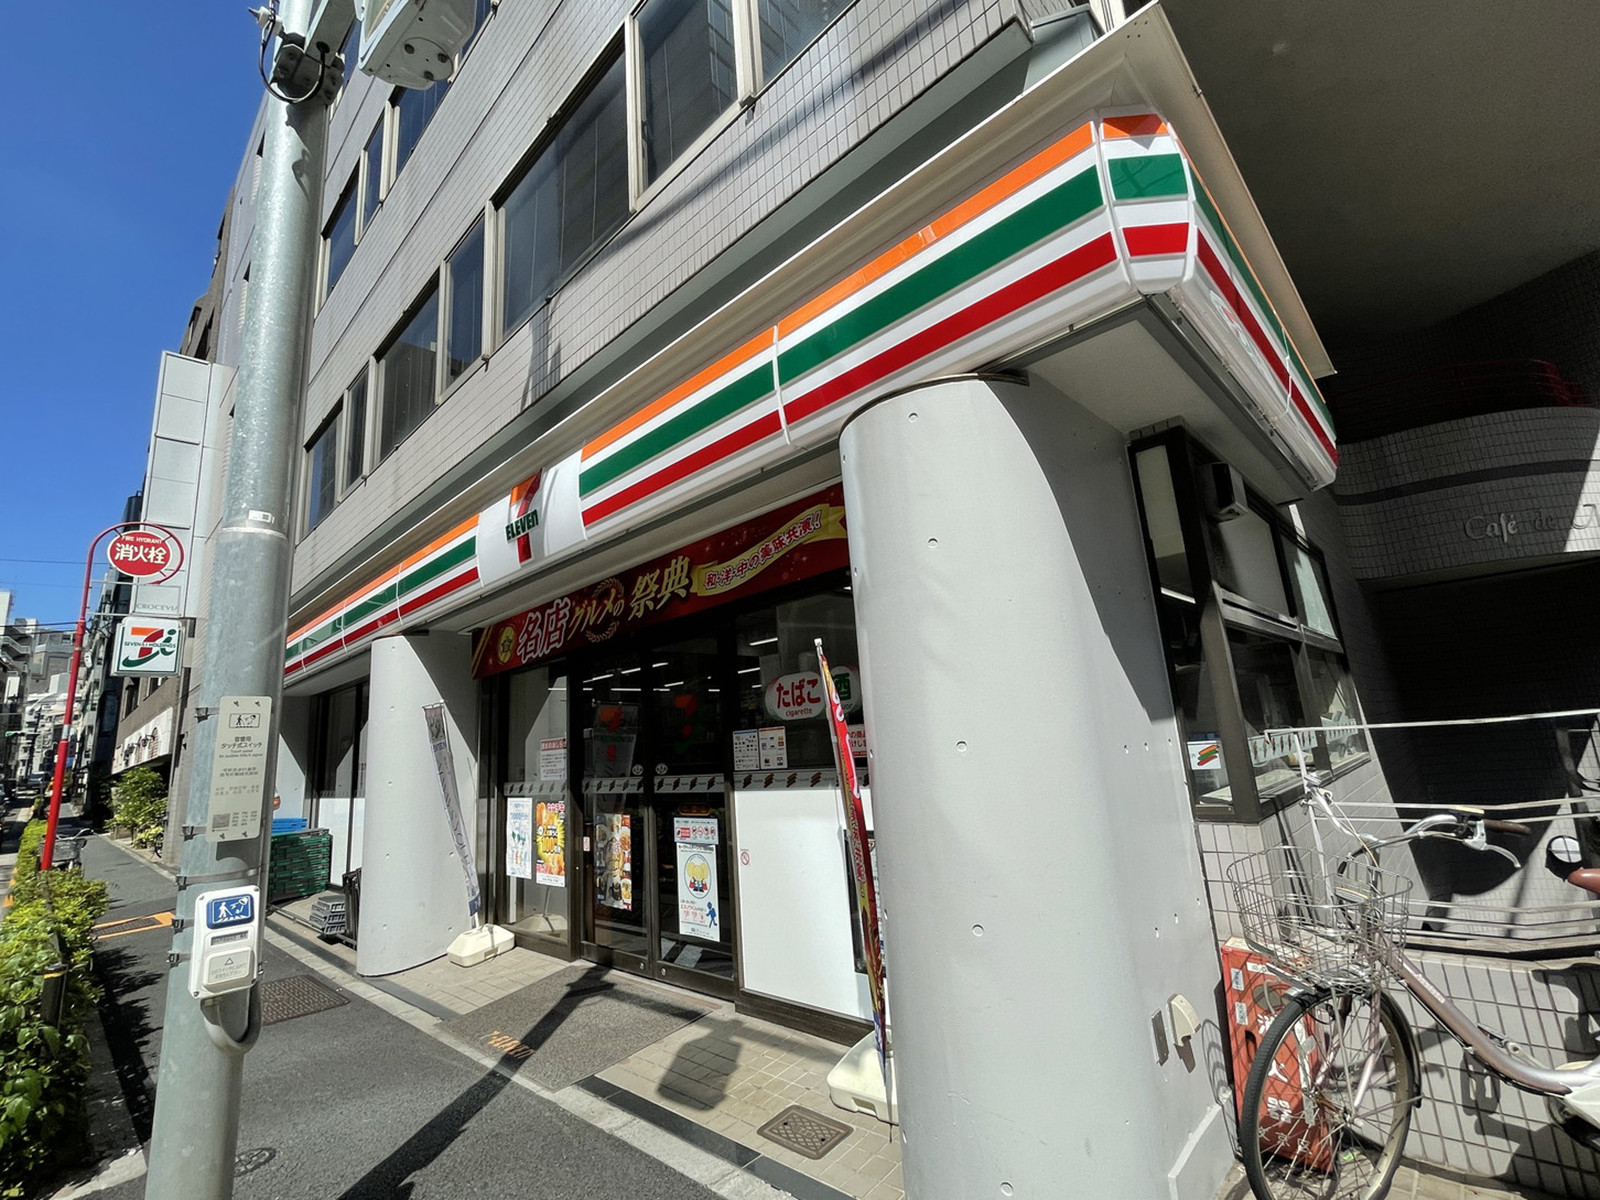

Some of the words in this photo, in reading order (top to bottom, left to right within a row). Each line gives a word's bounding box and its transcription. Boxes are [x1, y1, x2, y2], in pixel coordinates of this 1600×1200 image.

[1465, 512, 1518, 543] Café
[136, 536, 163, 544] HYDRANT
[114, 542, 167, 565] 消火栓
[776, 678, 821, 709] たばこ
[785, 707, 813, 717] cigarette
